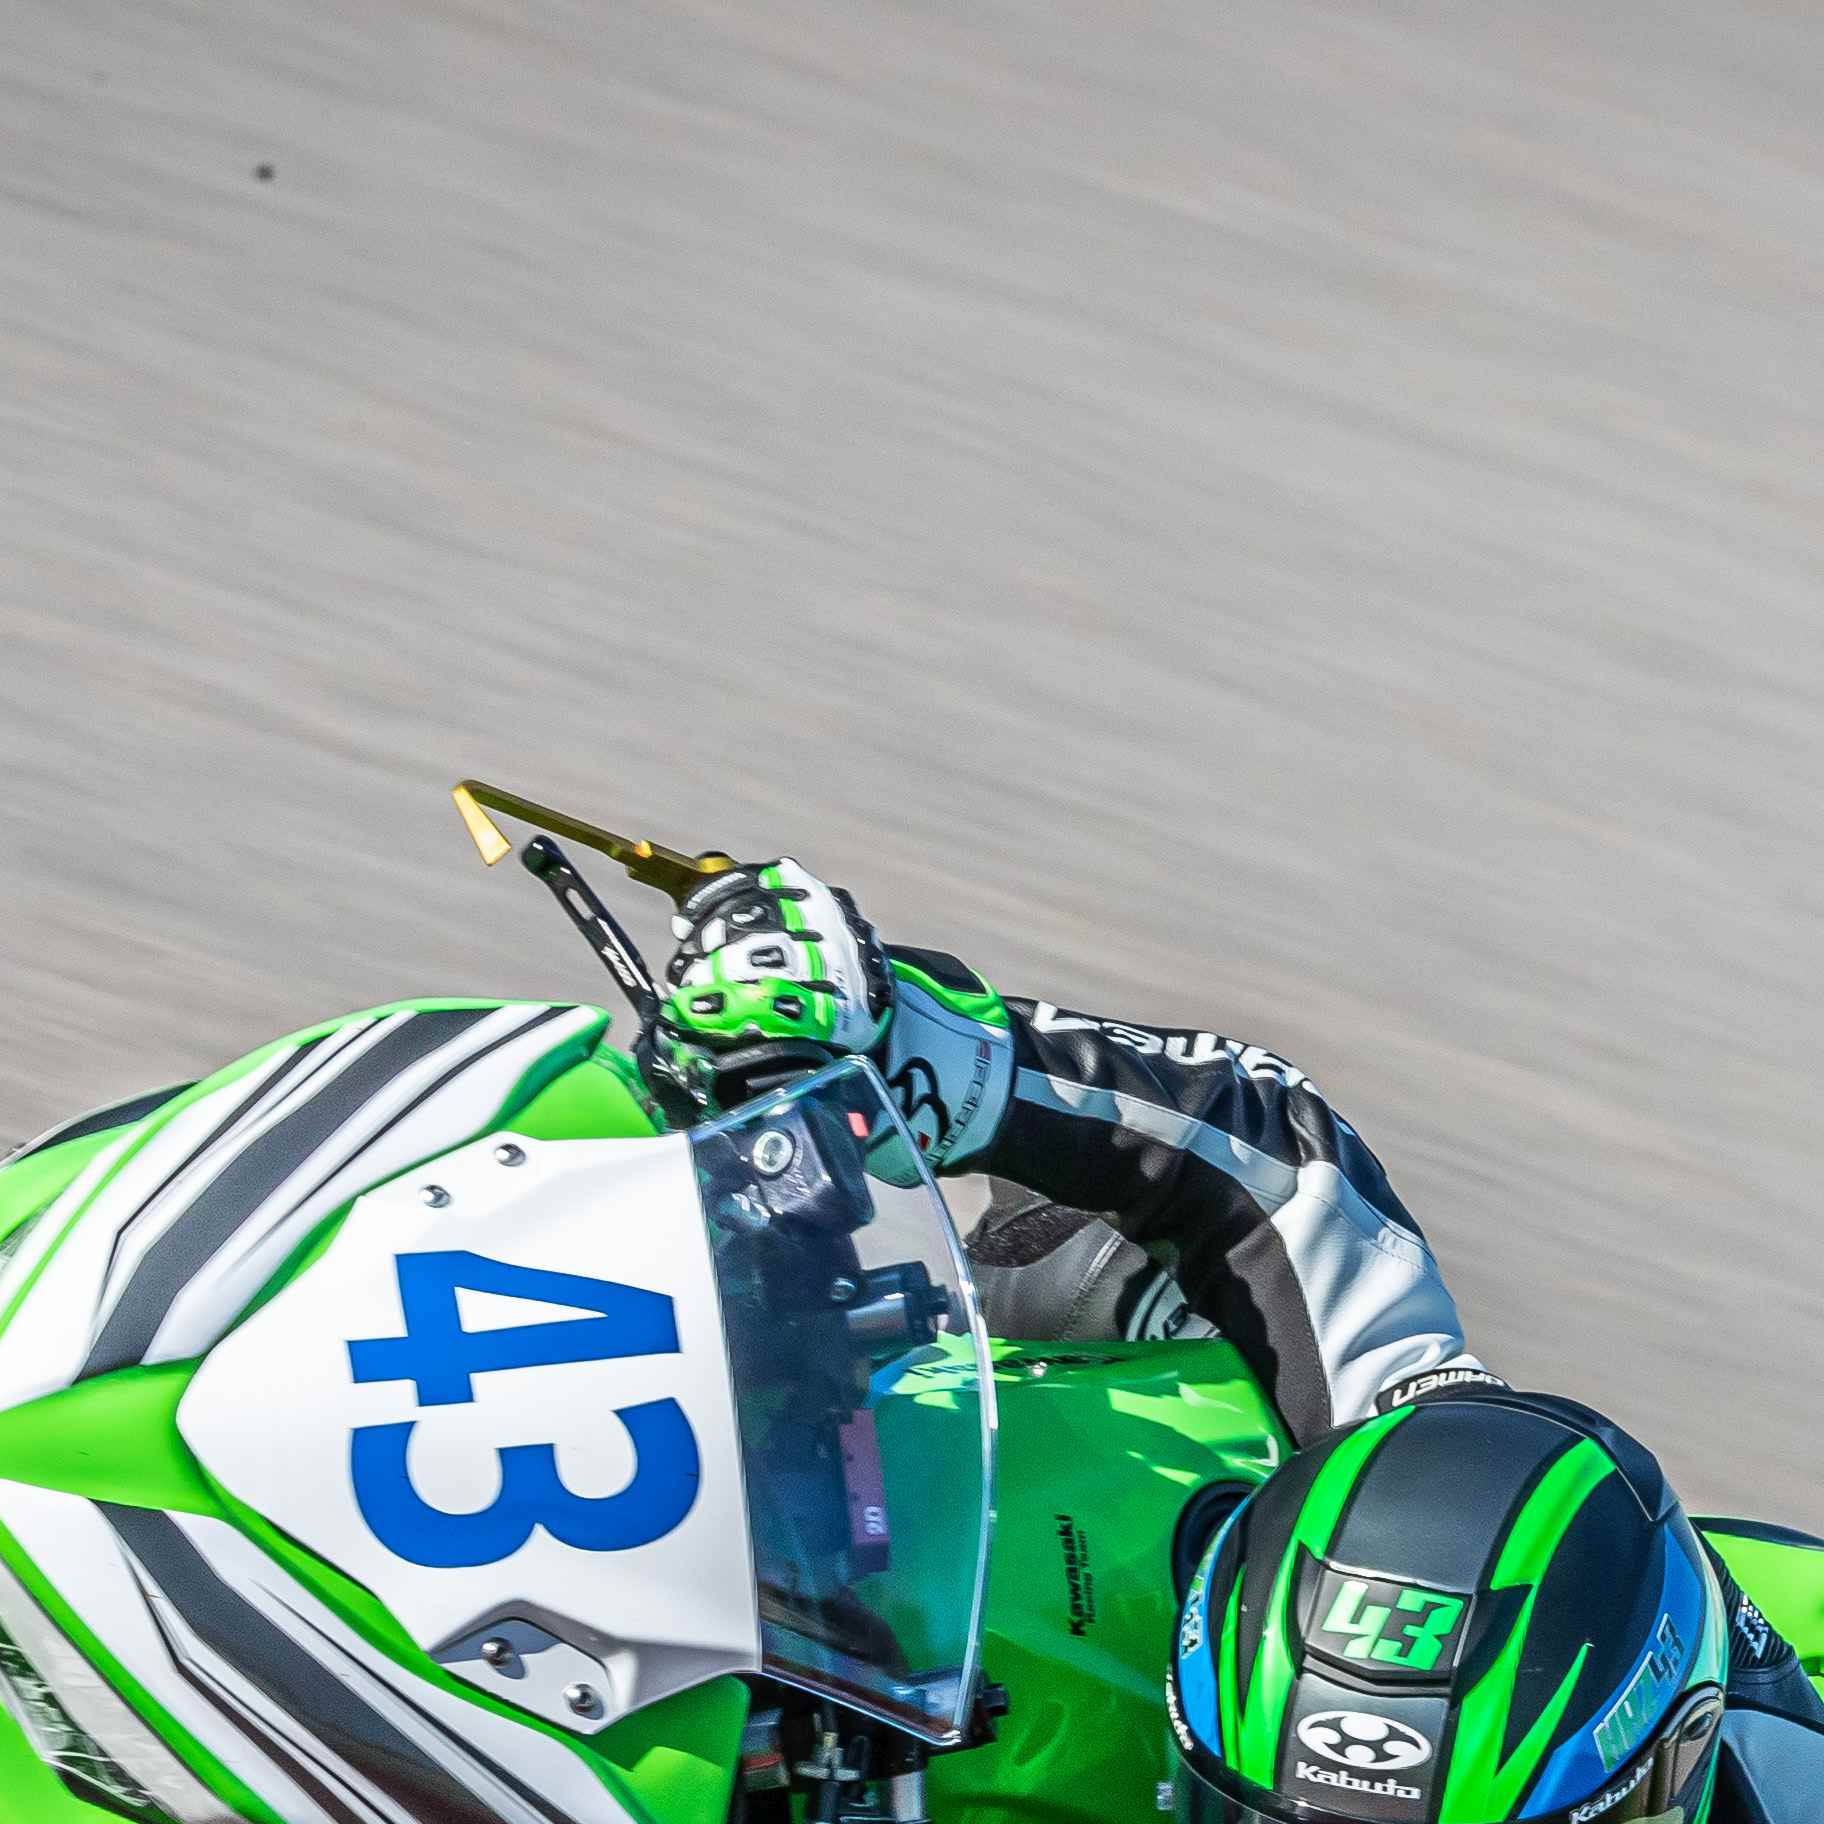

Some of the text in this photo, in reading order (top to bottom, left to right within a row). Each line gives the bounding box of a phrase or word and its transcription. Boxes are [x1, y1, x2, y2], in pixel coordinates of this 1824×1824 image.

[345, 1250, 701, 1568] 43
[1392, 1370, 1504, 1407] DAMEN
[1054, 1514, 1086, 1637] Kawasaki
[1322, 1580, 1464, 1671] 43
[1296, 1761, 1421, 1800] Kabuto
